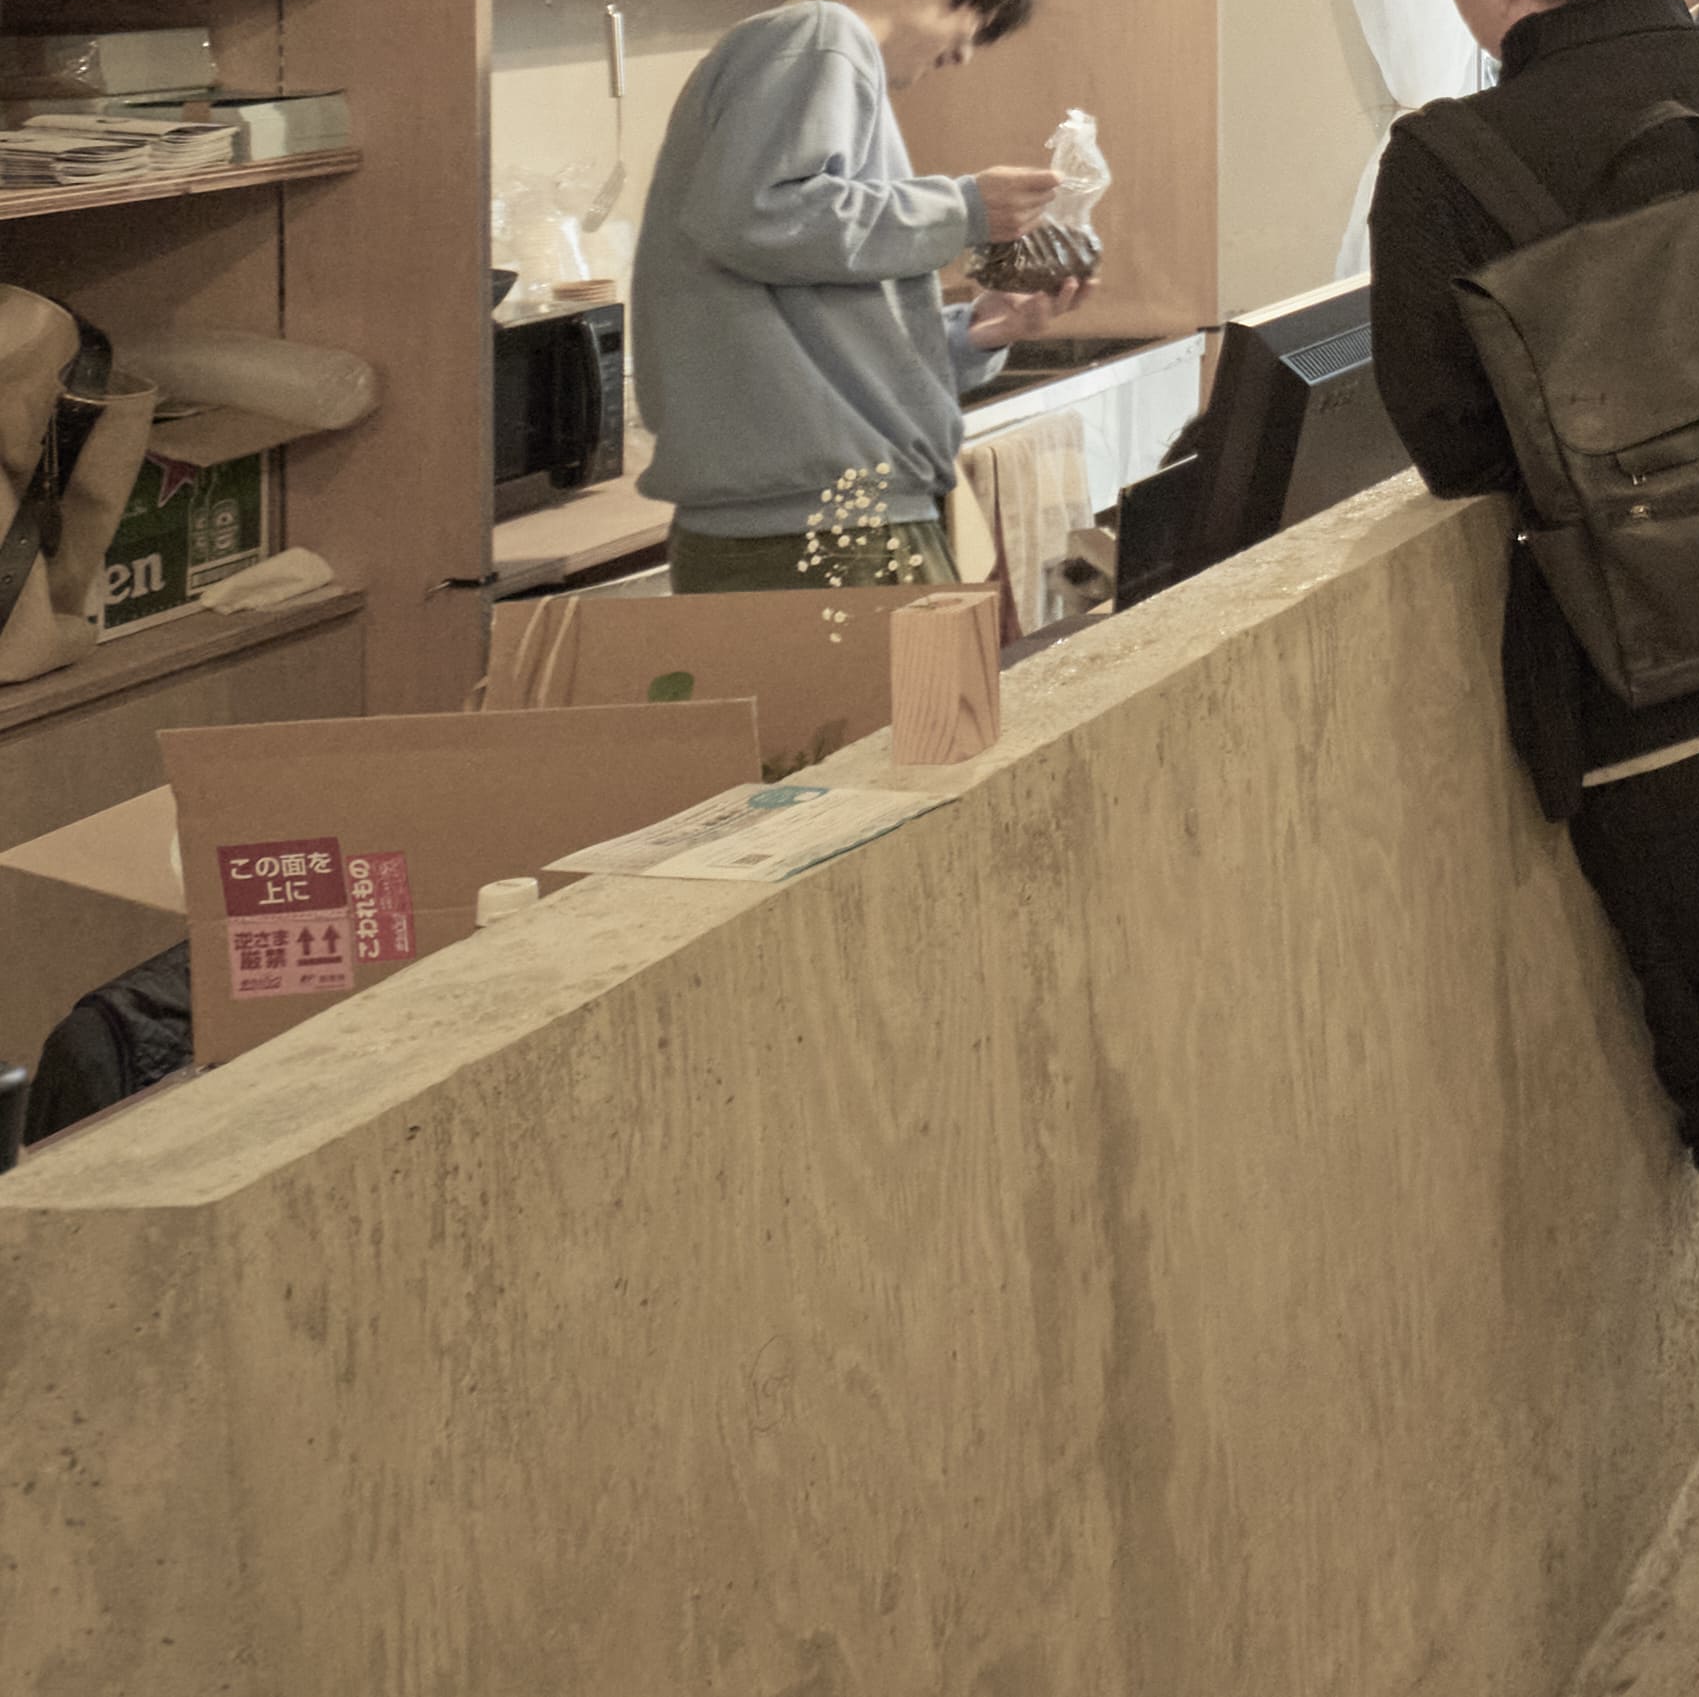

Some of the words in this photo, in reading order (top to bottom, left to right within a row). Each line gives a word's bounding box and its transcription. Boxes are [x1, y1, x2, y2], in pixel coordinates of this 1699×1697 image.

[230, 851, 334, 881] この面を
[258, 880, 311, 906] 上に
[348, 857, 381, 959] こわれもの
[234, 929, 290, 951] 逆さま
[240, 948, 288, 971] 厳禁
